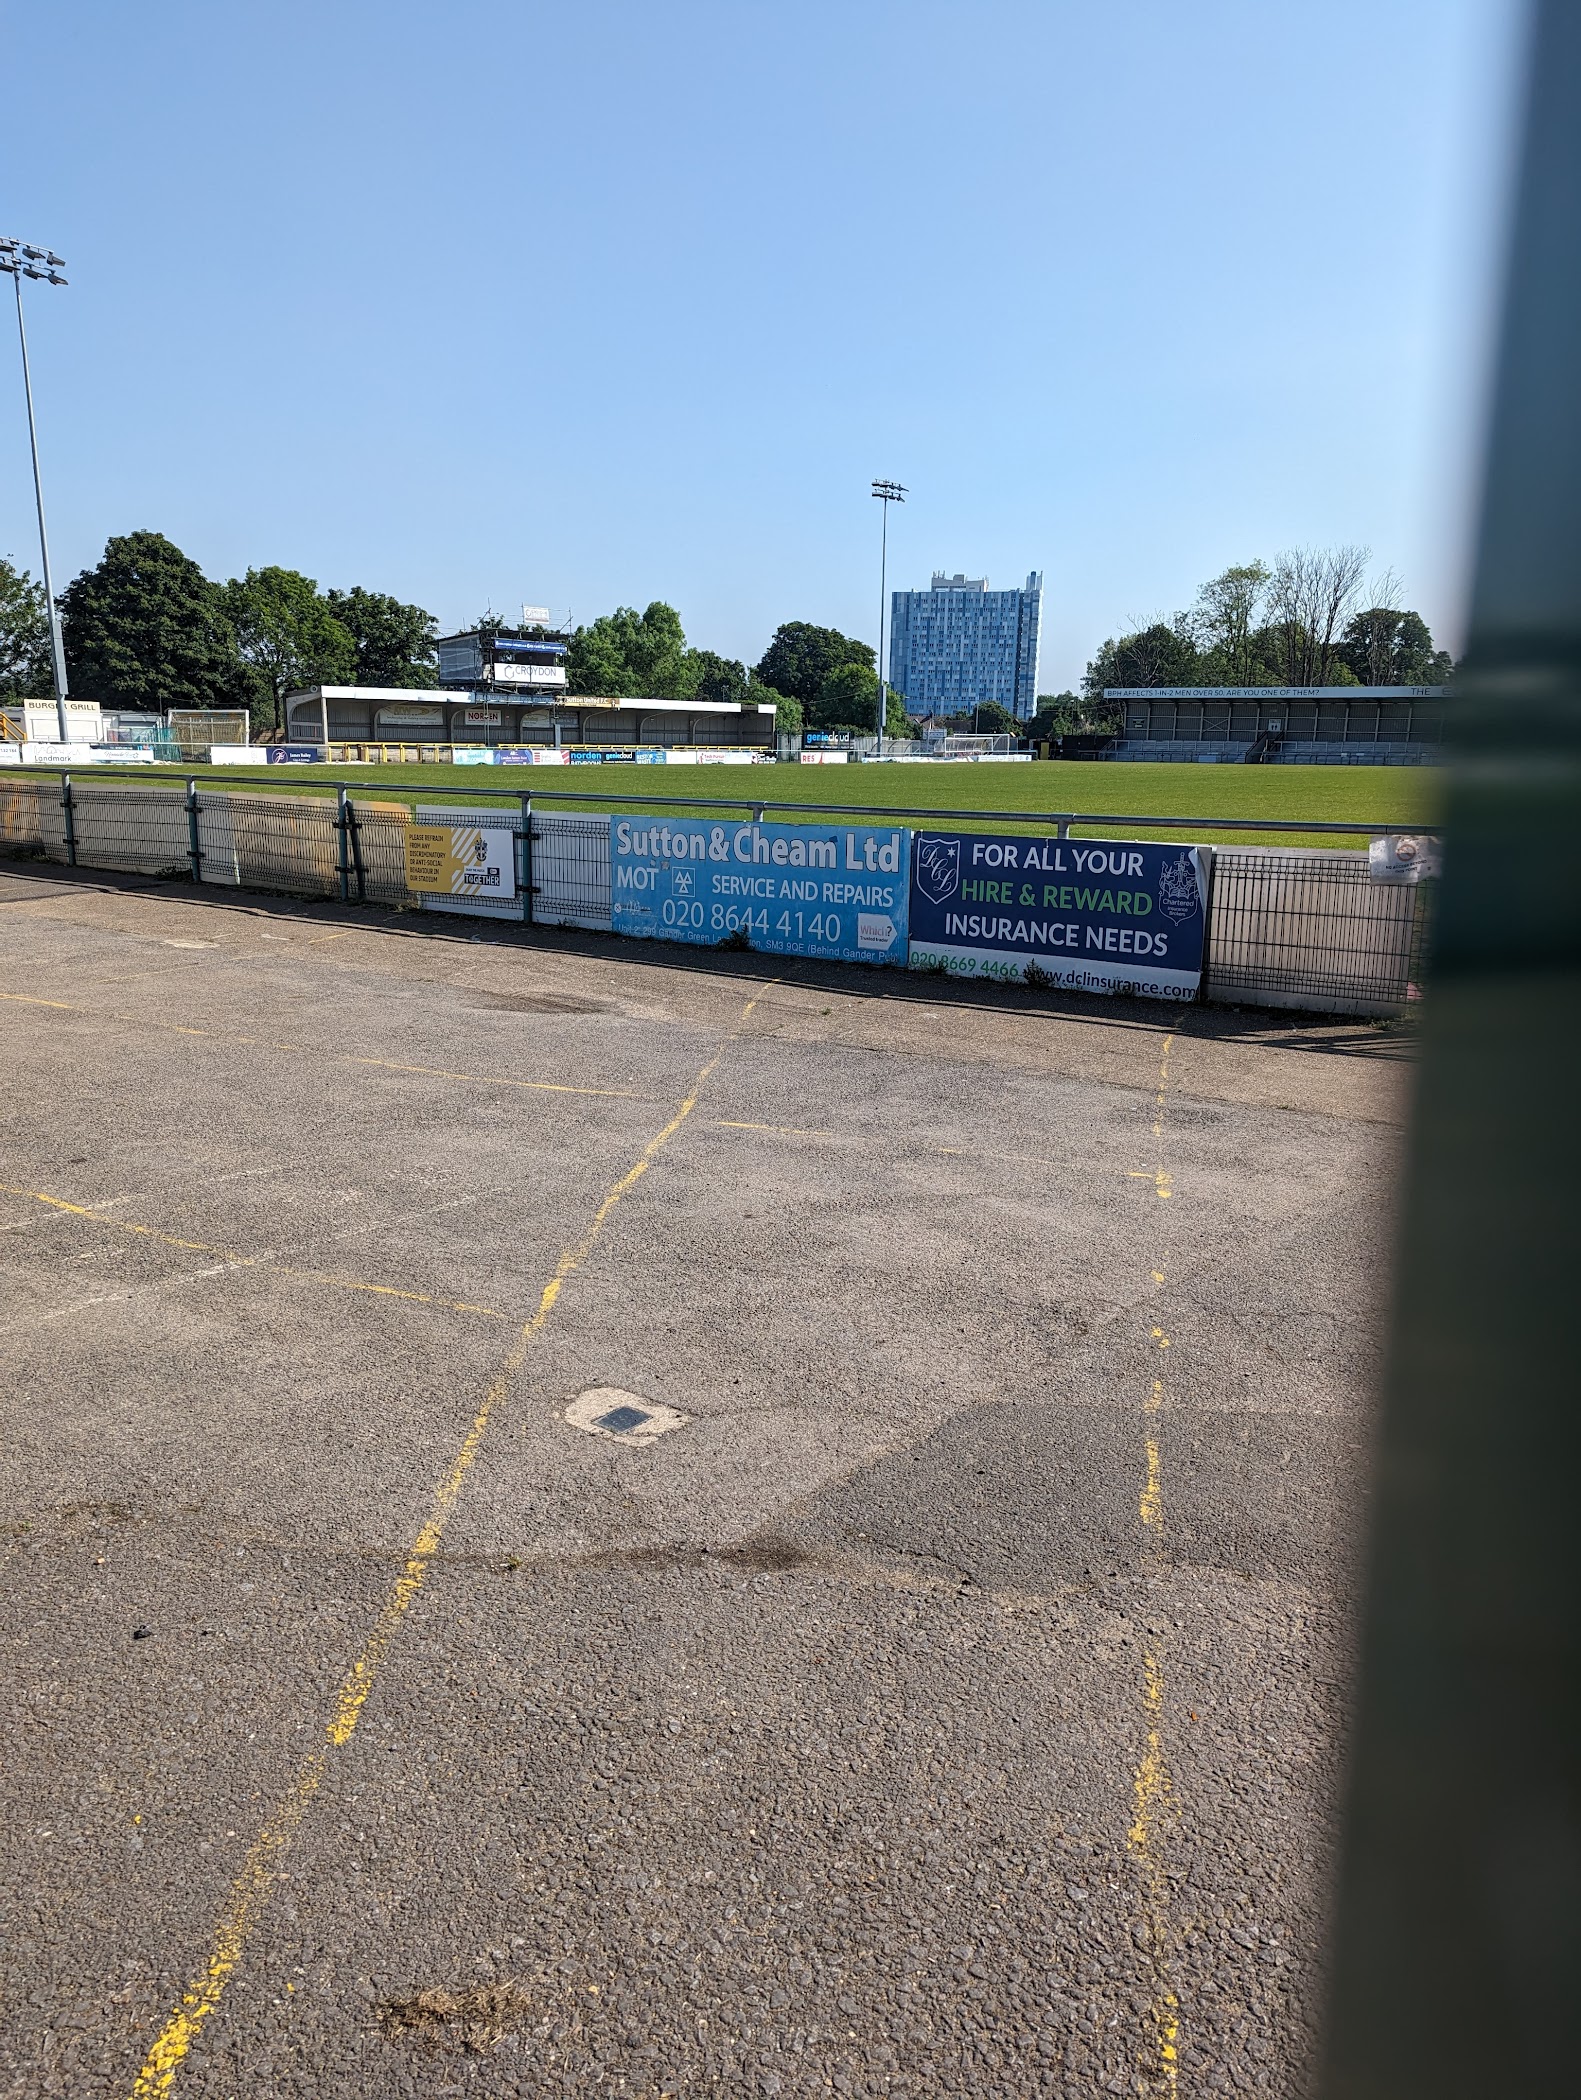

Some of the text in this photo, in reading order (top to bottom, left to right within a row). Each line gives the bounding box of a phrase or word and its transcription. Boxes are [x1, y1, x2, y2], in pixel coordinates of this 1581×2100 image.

[515, 665, 557, 677] CROYDON
[1123, 689, 1154, 697] AFFECTS
[1411, 687, 1431, 696] THE
[70, 703, 96, 711] GRILL
[570, 751, 602, 760] norden
[409, 833, 444, 842] PLEASE REFRAIN
[410, 850, 446, 859] DISCRIMINATORY
[845, 833, 900, 873] Ltd
[416, 859, 443, 867] ANTI-SOCIAL
[972, 843, 1143, 877] FOR ALL YOUR
[1392, 862, 1410, 870] ACCESS
[1410, 859, 1428, 867] BEYOND
[410, 867, 433, 875] BEHAVIOUR
[465, 874, 500, 886] TOGETHER
[617, 866, 659, 891] MOT
[712, 874, 894, 908] SERVICE AND REPAIRS
[961, 879, 1152, 916] HIRE & REWARD
[1162, 898, 1195, 907] Chartered
[662, 899, 704, 928] 020
[710, 903, 770, 936] 8644
[776, 910, 841, 942] 4140
[860, 924, 893, 938] Which?
[945, 913, 1168, 957] INSURANCE NEEDS
[643, 927, 657, 937] 299
[659, 928, 685, 940] Gander
[687, 931, 710, 943] Green
[766, 939, 784, 951] SM3
[786, 942, 804, 954] 9QE
[808, 944, 840, 957] (Behind
[843, 949, 874, 961] Gander
[860, 935, 876, 943] Trusted
[911, 951, 1019, 977] 020 8669 4466
